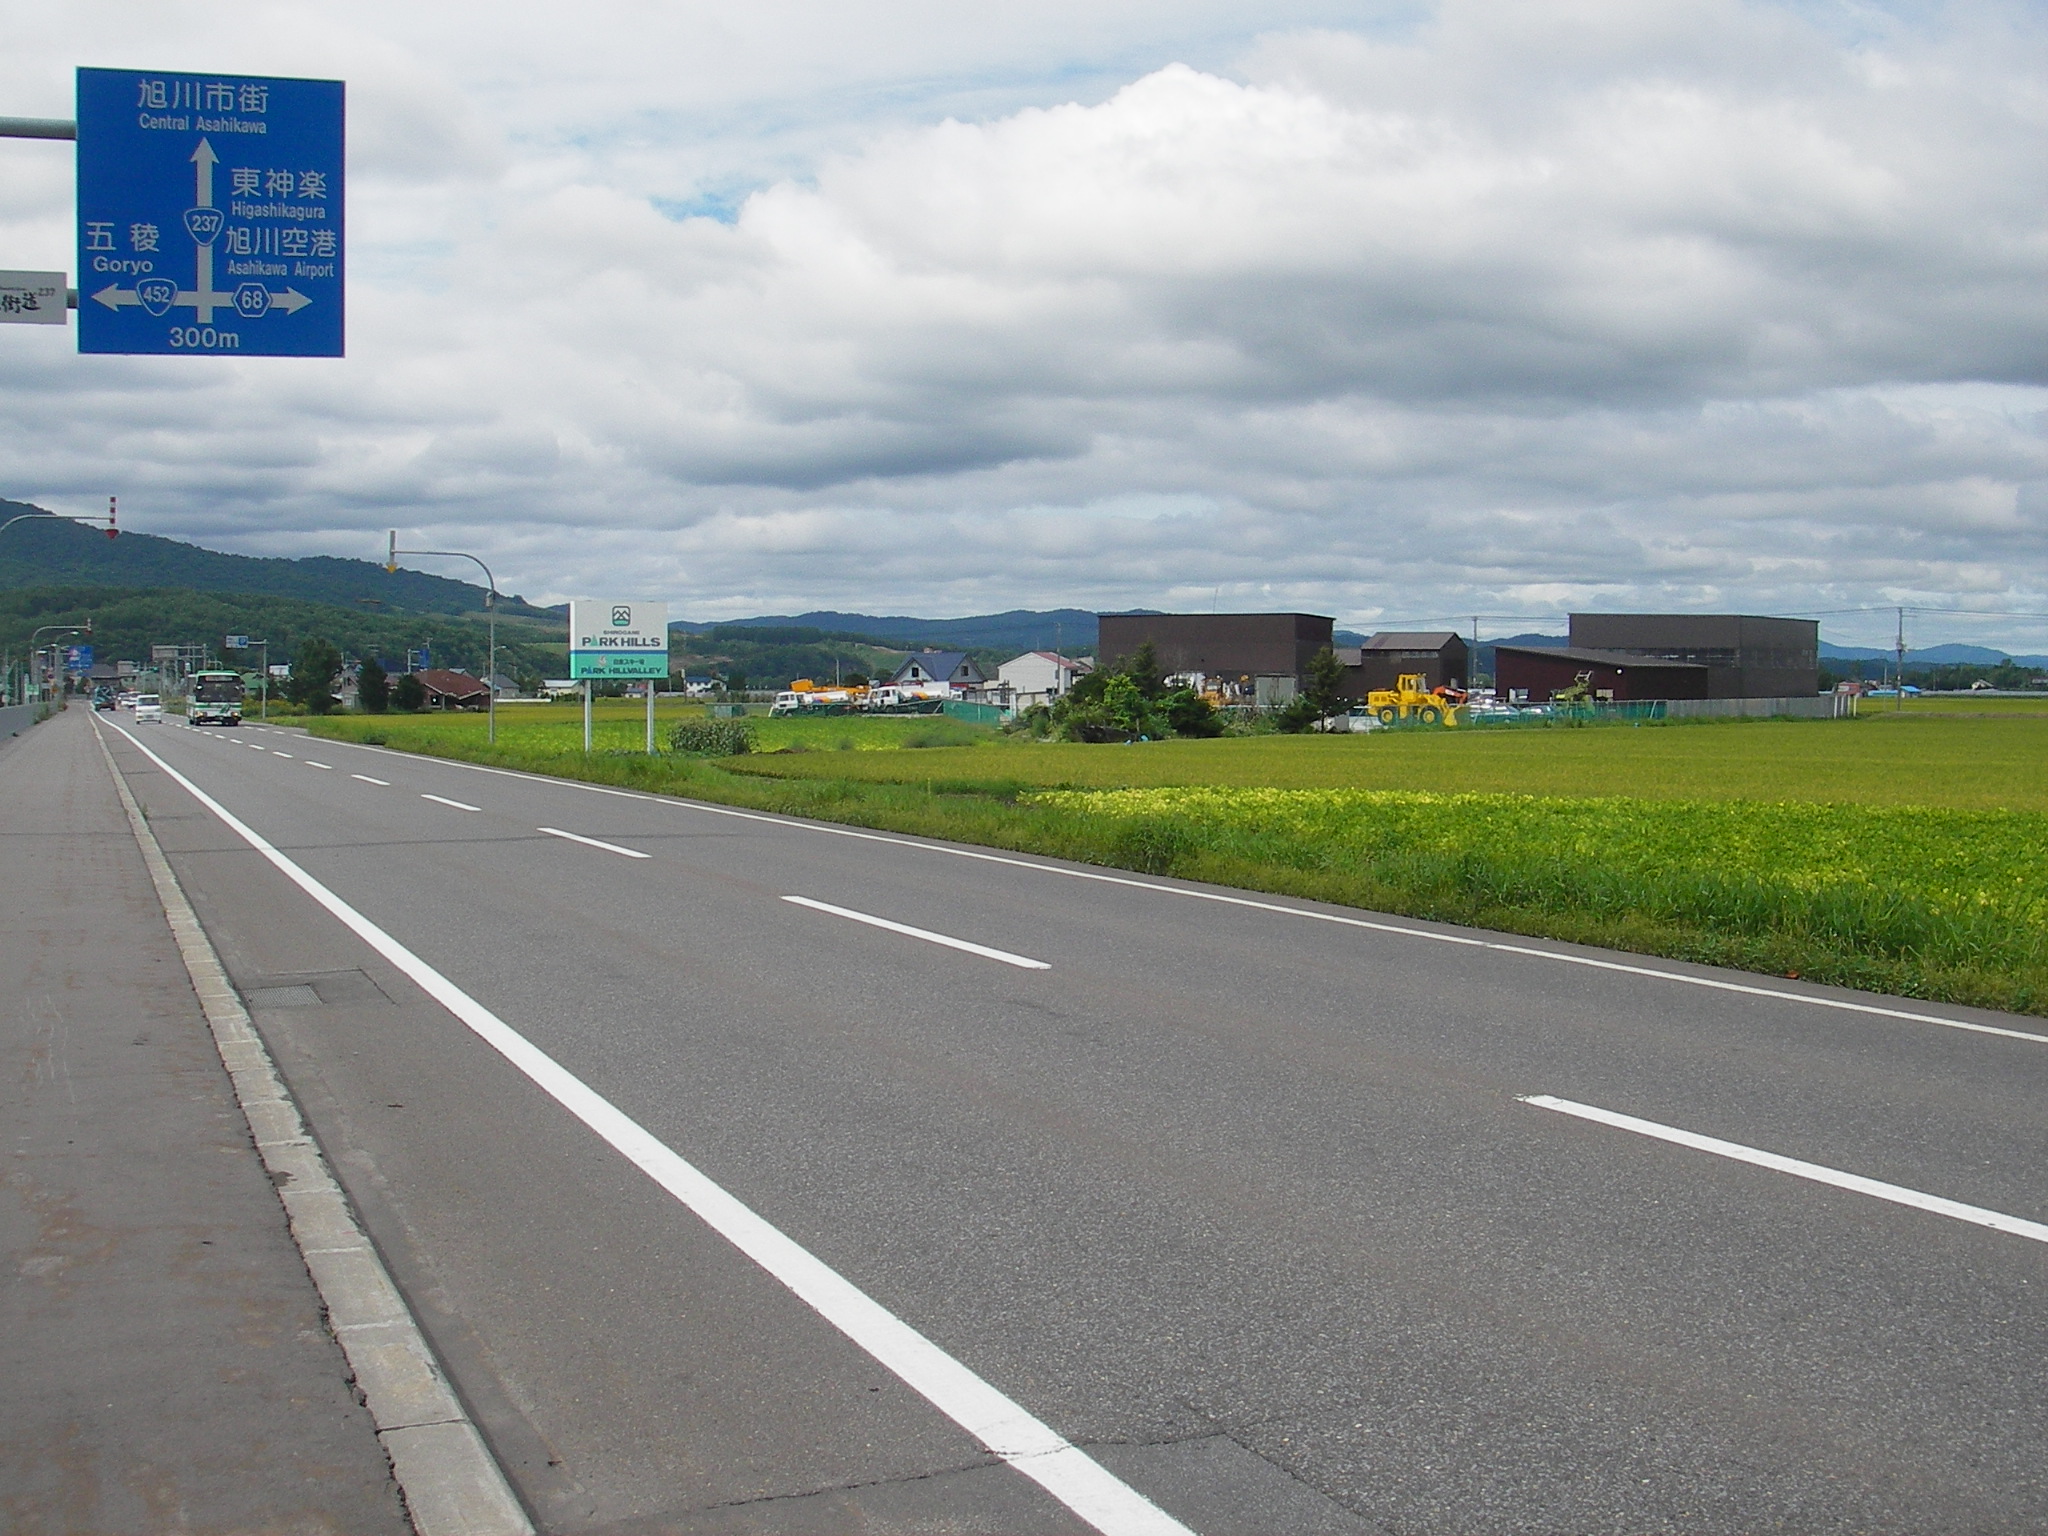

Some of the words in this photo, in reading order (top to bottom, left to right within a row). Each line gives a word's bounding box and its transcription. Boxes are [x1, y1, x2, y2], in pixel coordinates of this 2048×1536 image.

[137, 79, 269, 113] 旭川市街
[139, 114, 189, 130] Central
[196, 117, 267, 134] Asahikawa
[231, 167, 328, 200] 東神楽
[232, 202, 326, 222] Higashikagura
[192, 215, 218, 233] 237
[86, 222, 160, 253] 五稜
[225, 226, 337, 258] 旭川空港
[93, 257, 153, 276] Goryo
[227, 260, 288, 277] Asahikawa
[294, 262, 334, 280] Airport
[0, 292, 41, 314] 街道
[38, 287, 56, 297] 237
[143, 286, 170, 303] 452
[241, 290, 263, 309] 68
[170, 328, 240, 348] 300m
[582, 635, 620, 647] PARK
[621, 637, 661, 647] HILLS
[581, 667, 606, 675] PARK
[608, 667, 662, 675] HILLVALLEY
